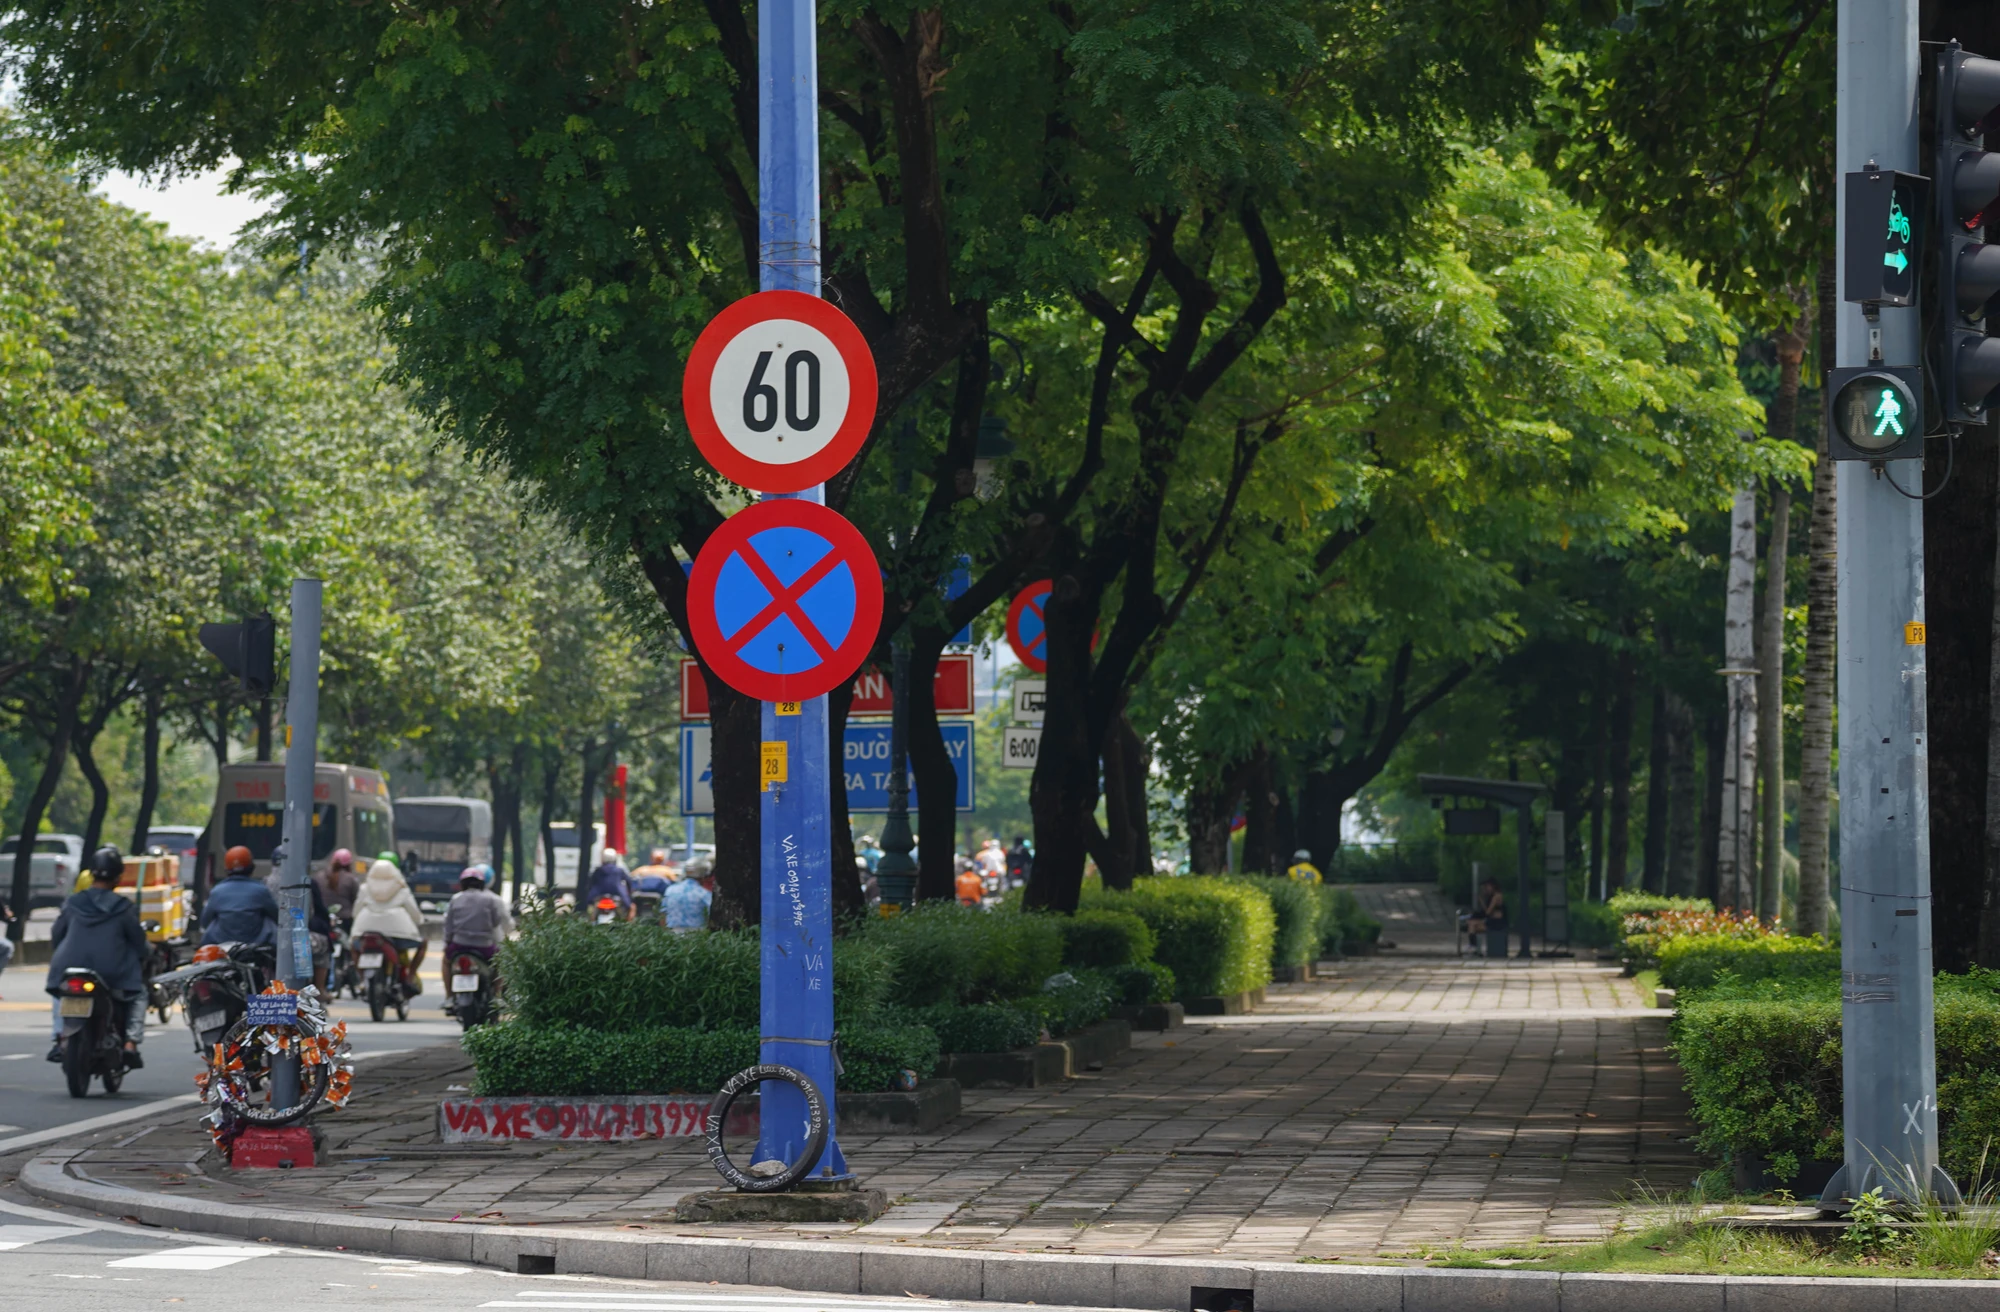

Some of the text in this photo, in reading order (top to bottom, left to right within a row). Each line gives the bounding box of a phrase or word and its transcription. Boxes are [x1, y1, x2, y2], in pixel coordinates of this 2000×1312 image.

[743, 350, 820, 432] 60
[782, 702, 795, 712] 28
[844, 732, 890, 760] ĐƯỜ
[1010, 738, 1036, 758] 6:00
[765, 758, 779, 775] 28
[786, 853, 799, 868] XE
[808, 977, 822, 991] XE
[739, 1065, 760, 1082] XE
[491, 1103, 534, 1139] XE
[705, 1135, 723, 1154] XE
